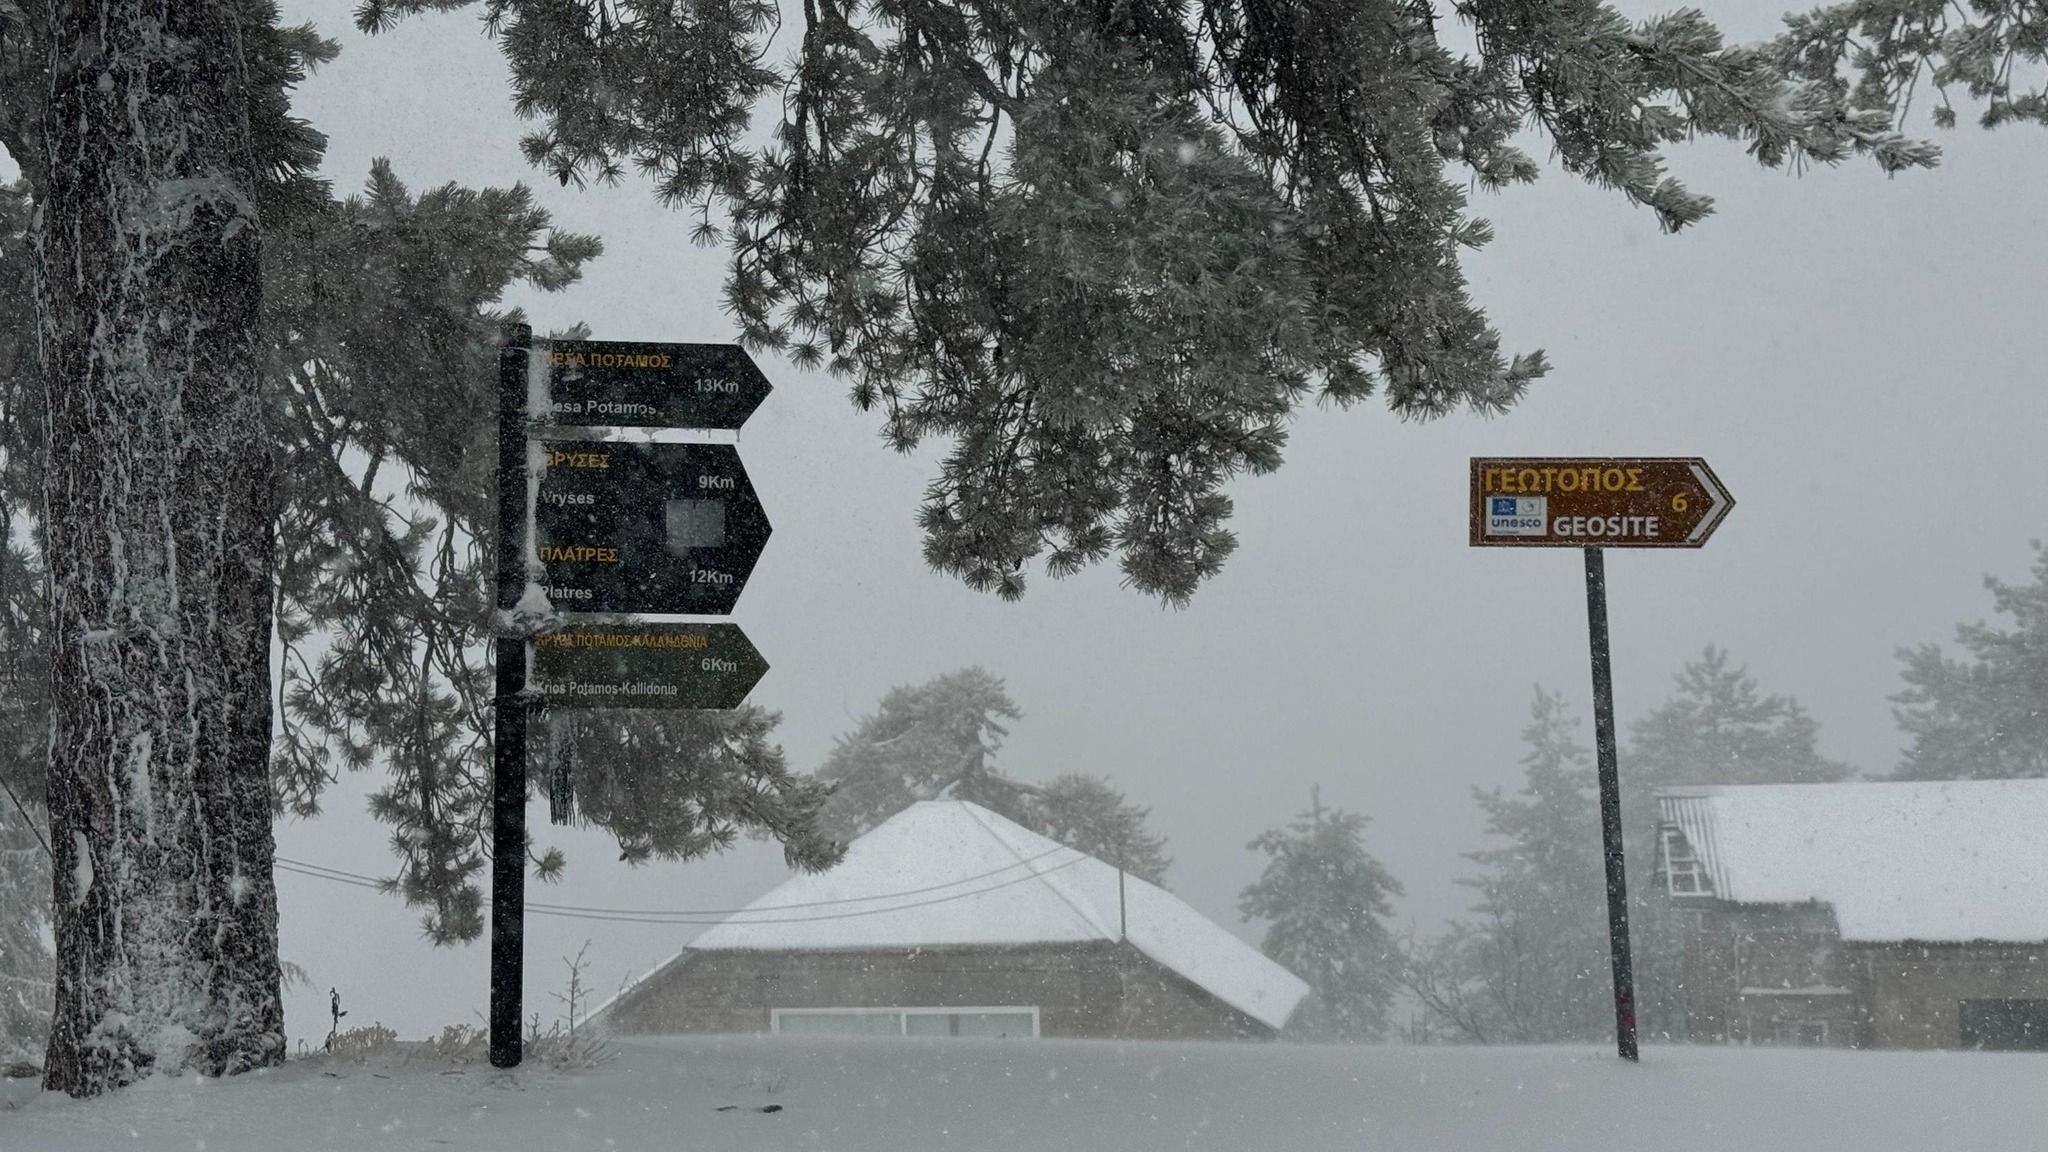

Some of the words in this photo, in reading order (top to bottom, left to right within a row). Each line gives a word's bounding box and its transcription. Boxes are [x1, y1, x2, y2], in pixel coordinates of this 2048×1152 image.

[590, 353, 672, 368] ΠΟΤΑΜΟΣ
[695, 379, 739, 392] 13Km
[549, 402, 582, 413] esa
[587, 400, 657, 415] Potamos
[699, 475, 735, 489] 9Km
[1485, 467, 1644, 493] ΓΕΩΤΟΠΟΣ
[1671, 492, 1688, 513] 6
[1491, 518, 1542, 528] unesco
[1552, 516, 1659, 537] GEOSITE
[539, 547, 618, 562] ΠΛΑΤΡΕΣ
[689, 569, 733, 584] 12Km
[701, 658, 737, 672] 6Km
[535, 681, 566, 694] Krios
